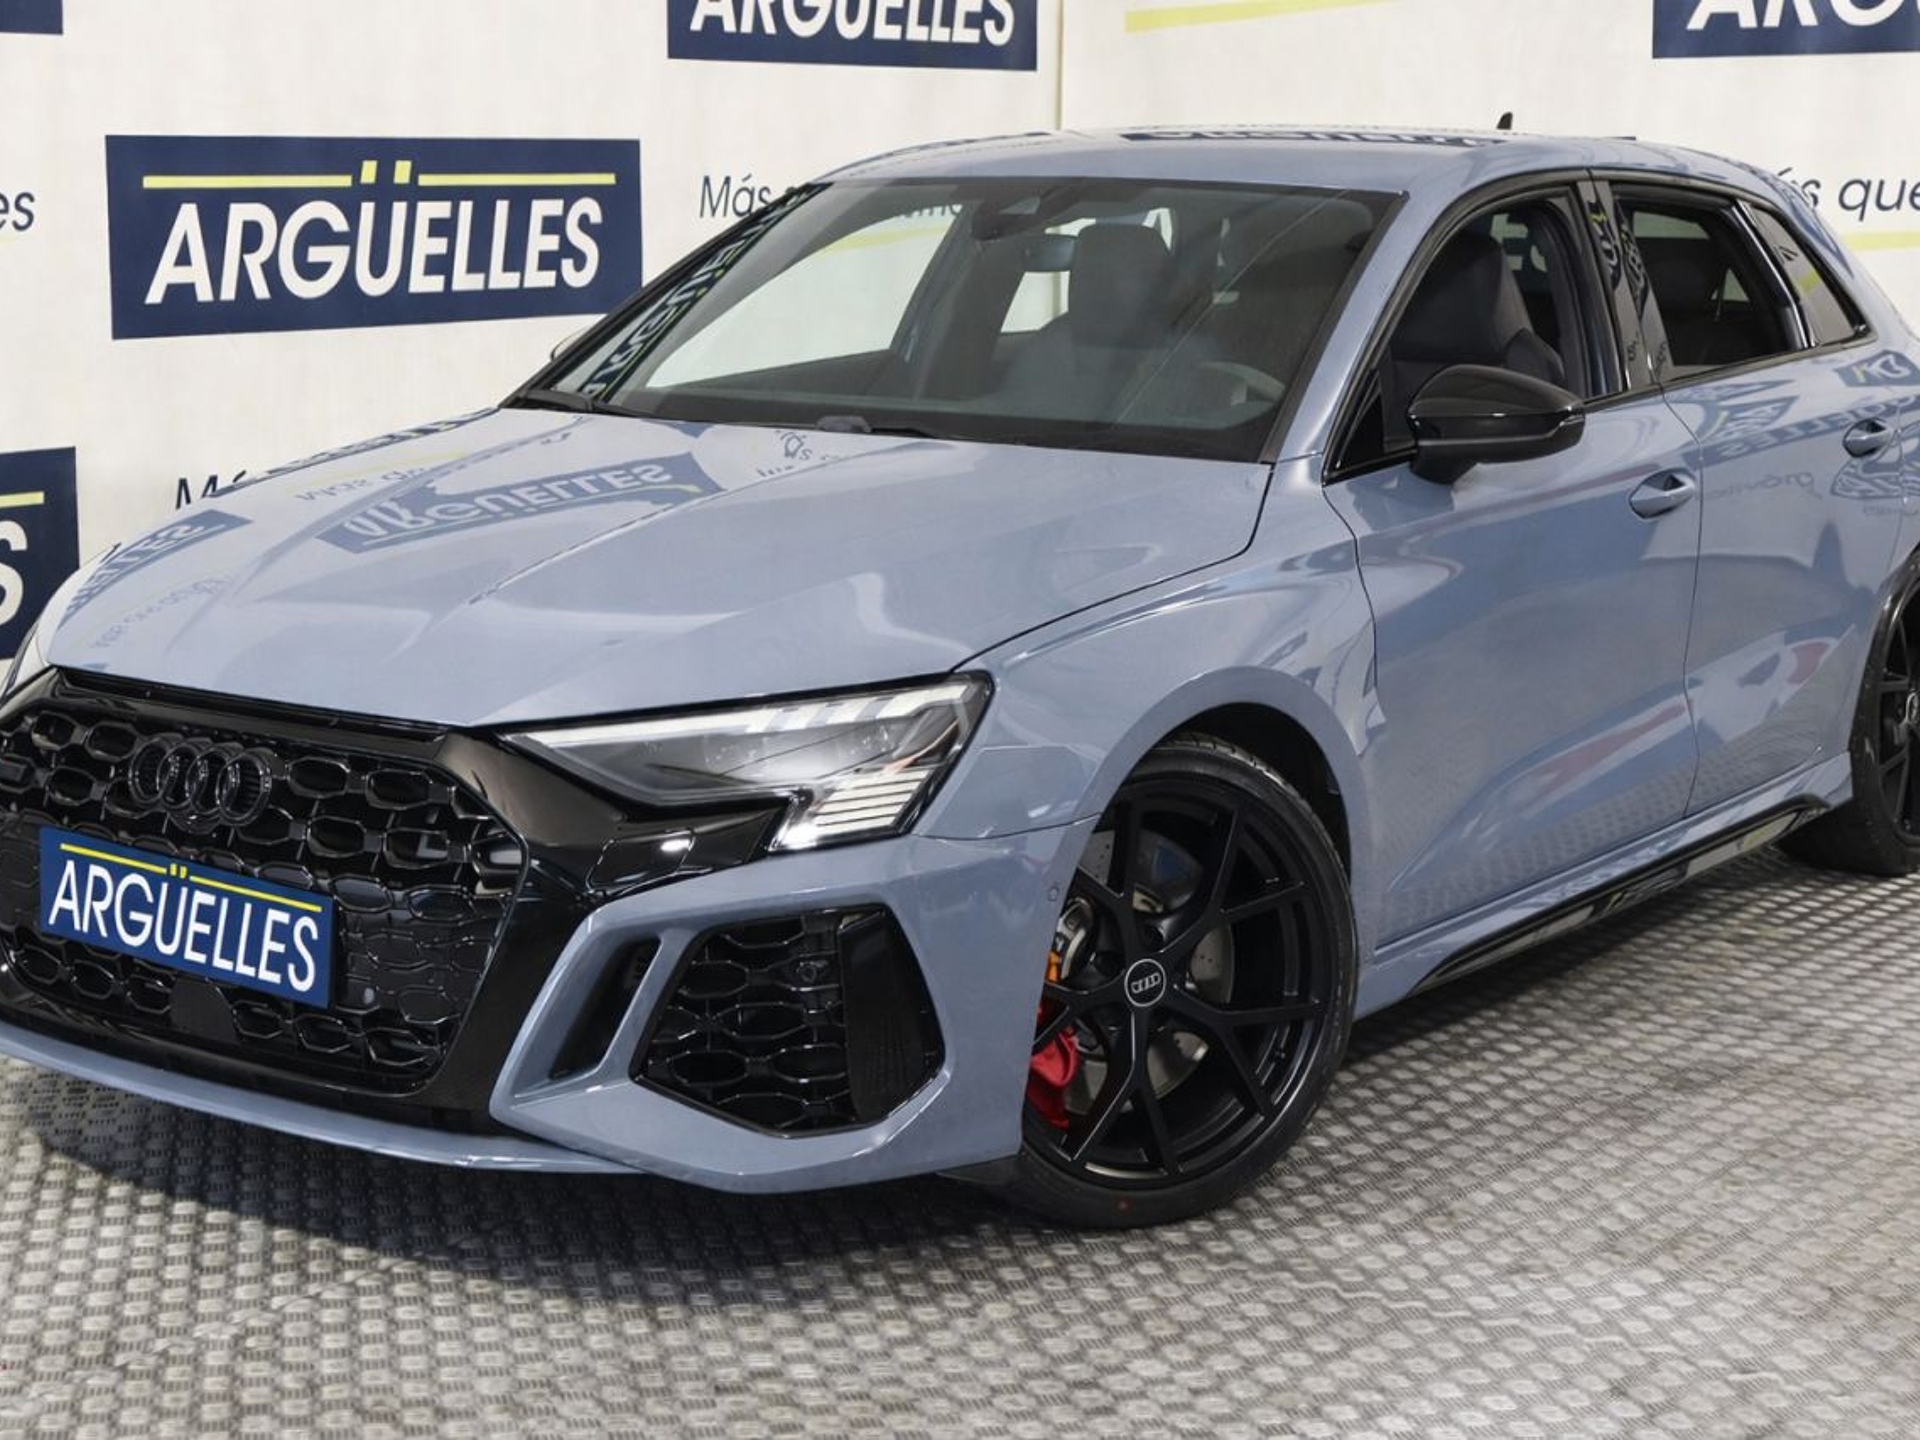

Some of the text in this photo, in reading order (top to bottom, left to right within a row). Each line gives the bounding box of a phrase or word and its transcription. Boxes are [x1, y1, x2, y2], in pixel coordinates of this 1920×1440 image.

[144, 160, 603, 305] ARGÜELLES
[700, 173, 771, 218] Más
[48, 859, 319, 993] ARGÜELLES
